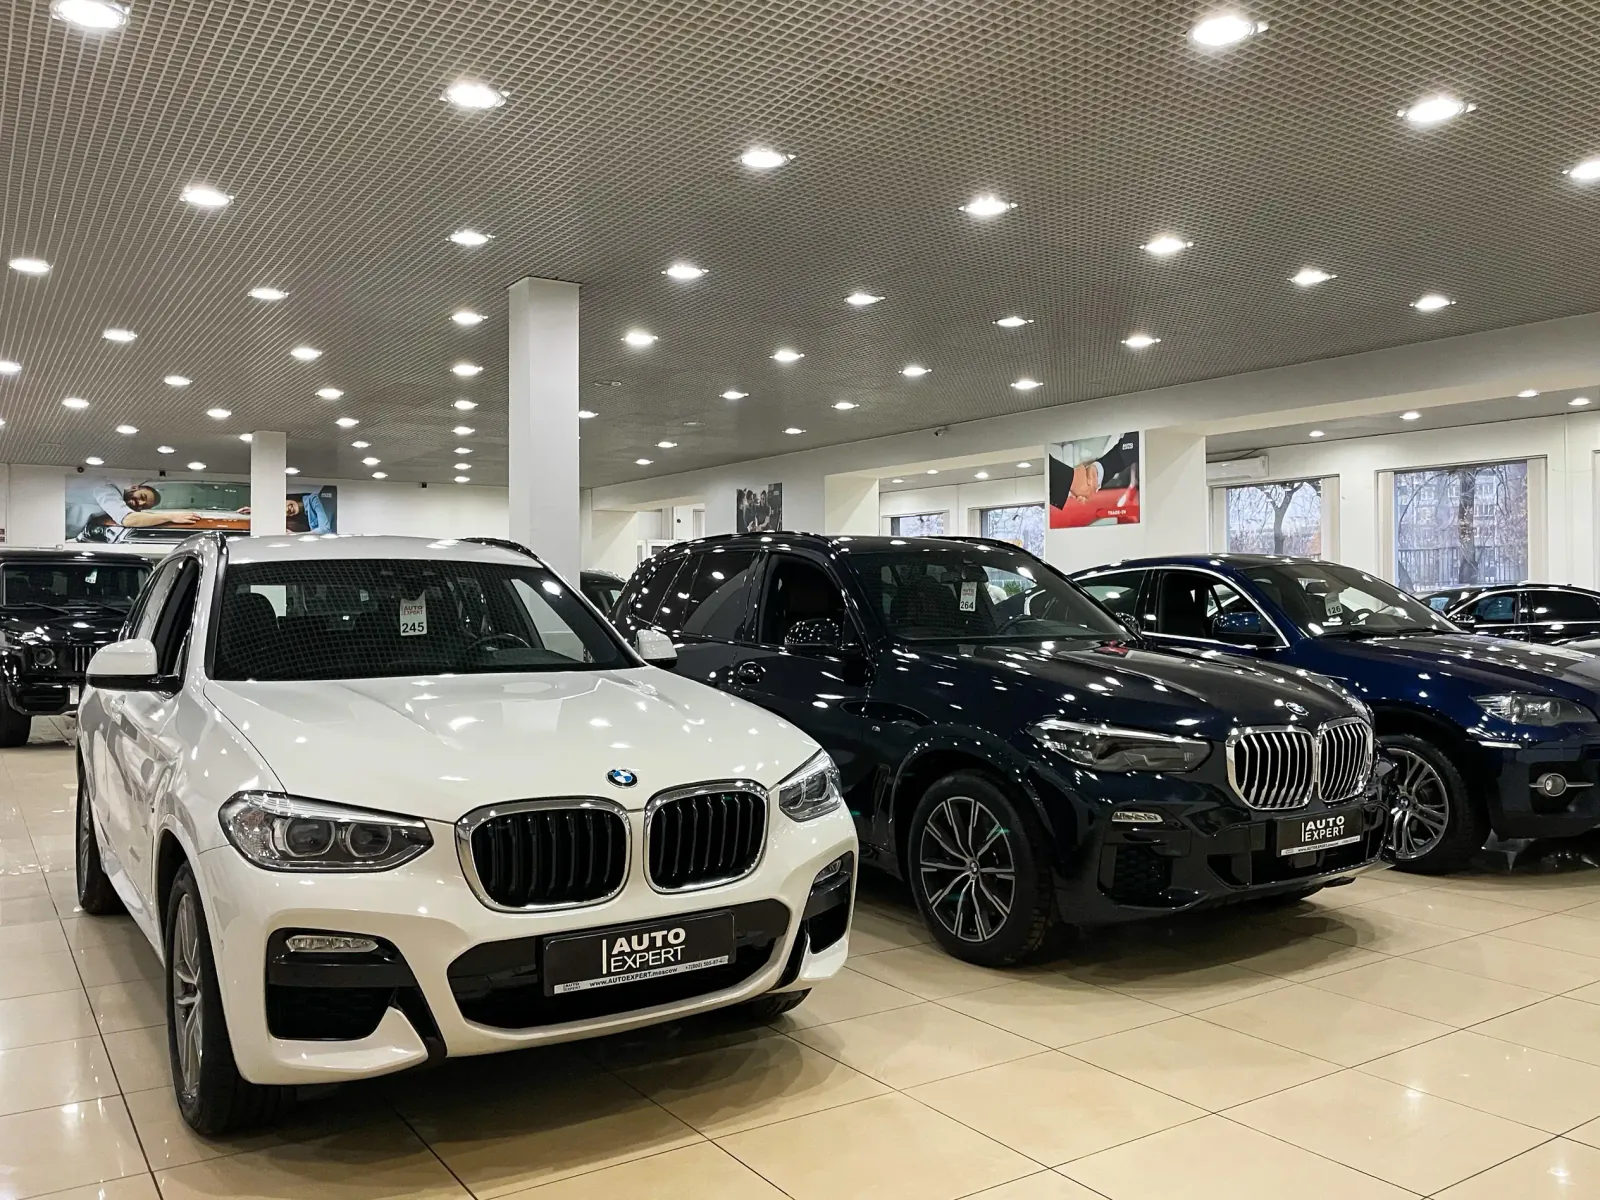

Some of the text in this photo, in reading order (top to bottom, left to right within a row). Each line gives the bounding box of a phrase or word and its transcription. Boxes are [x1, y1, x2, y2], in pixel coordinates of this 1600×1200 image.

[960, 601, 974, 610] 264
[1327, 605, 1341, 614] 126
[401, 622, 425, 633] 245
[1306, 816, 1345, 831] AUTO
[1305, 825, 1345, 842] EXPERT
[611, 927, 686, 955] AUTO
[610, 945, 686, 973] EXPERT
[589, 967, 678, 987] www.AUTOEXPERT.moscow
